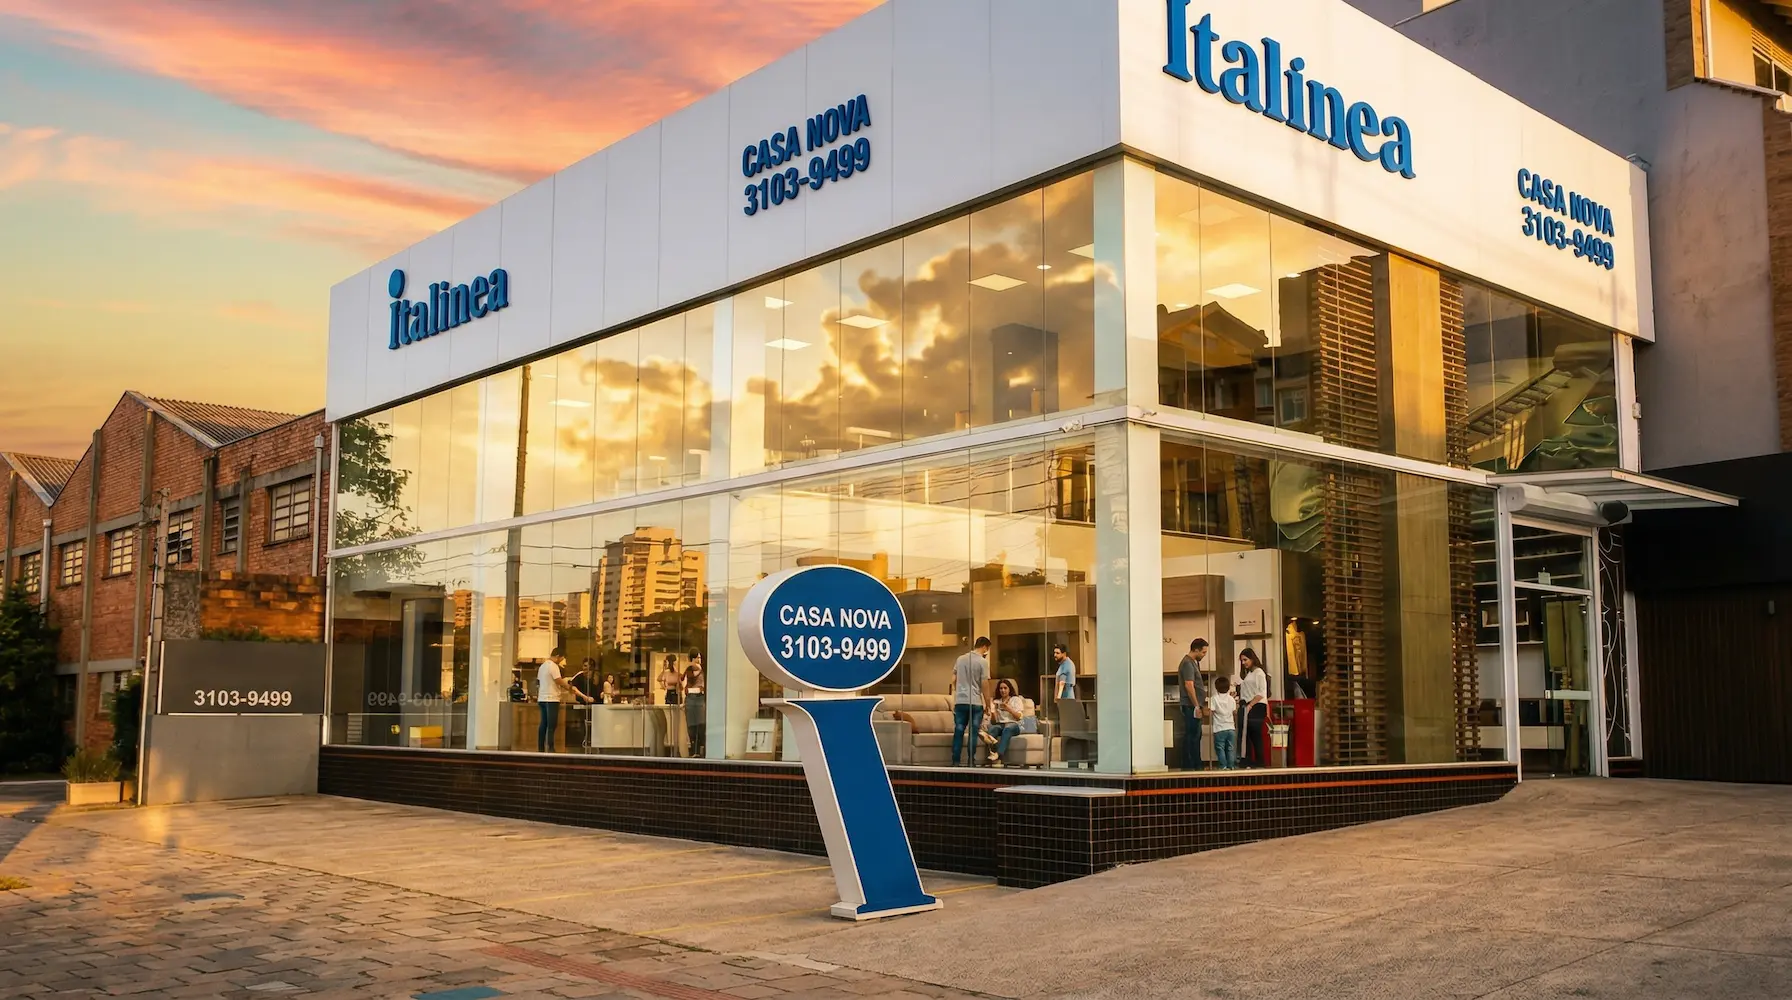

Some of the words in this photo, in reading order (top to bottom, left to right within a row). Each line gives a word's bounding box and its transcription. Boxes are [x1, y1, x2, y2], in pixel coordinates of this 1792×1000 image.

[742, 125, 801, 178] CASA
[806, 93, 871, 152] NOVA
[743, 137, 871, 216] 3103-9499
[1517, 168, 1567, 216] CASA
[1569, 191, 1615, 238] NOVA
[1521, 205, 1615, 271] 3103-9499
[779, 604, 836, 627] CASA
[840, 608, 892, 630] NOVA
[780, 634, 891, 662] 3103-9499
[193, 689, 293, 707] 3103-9499
